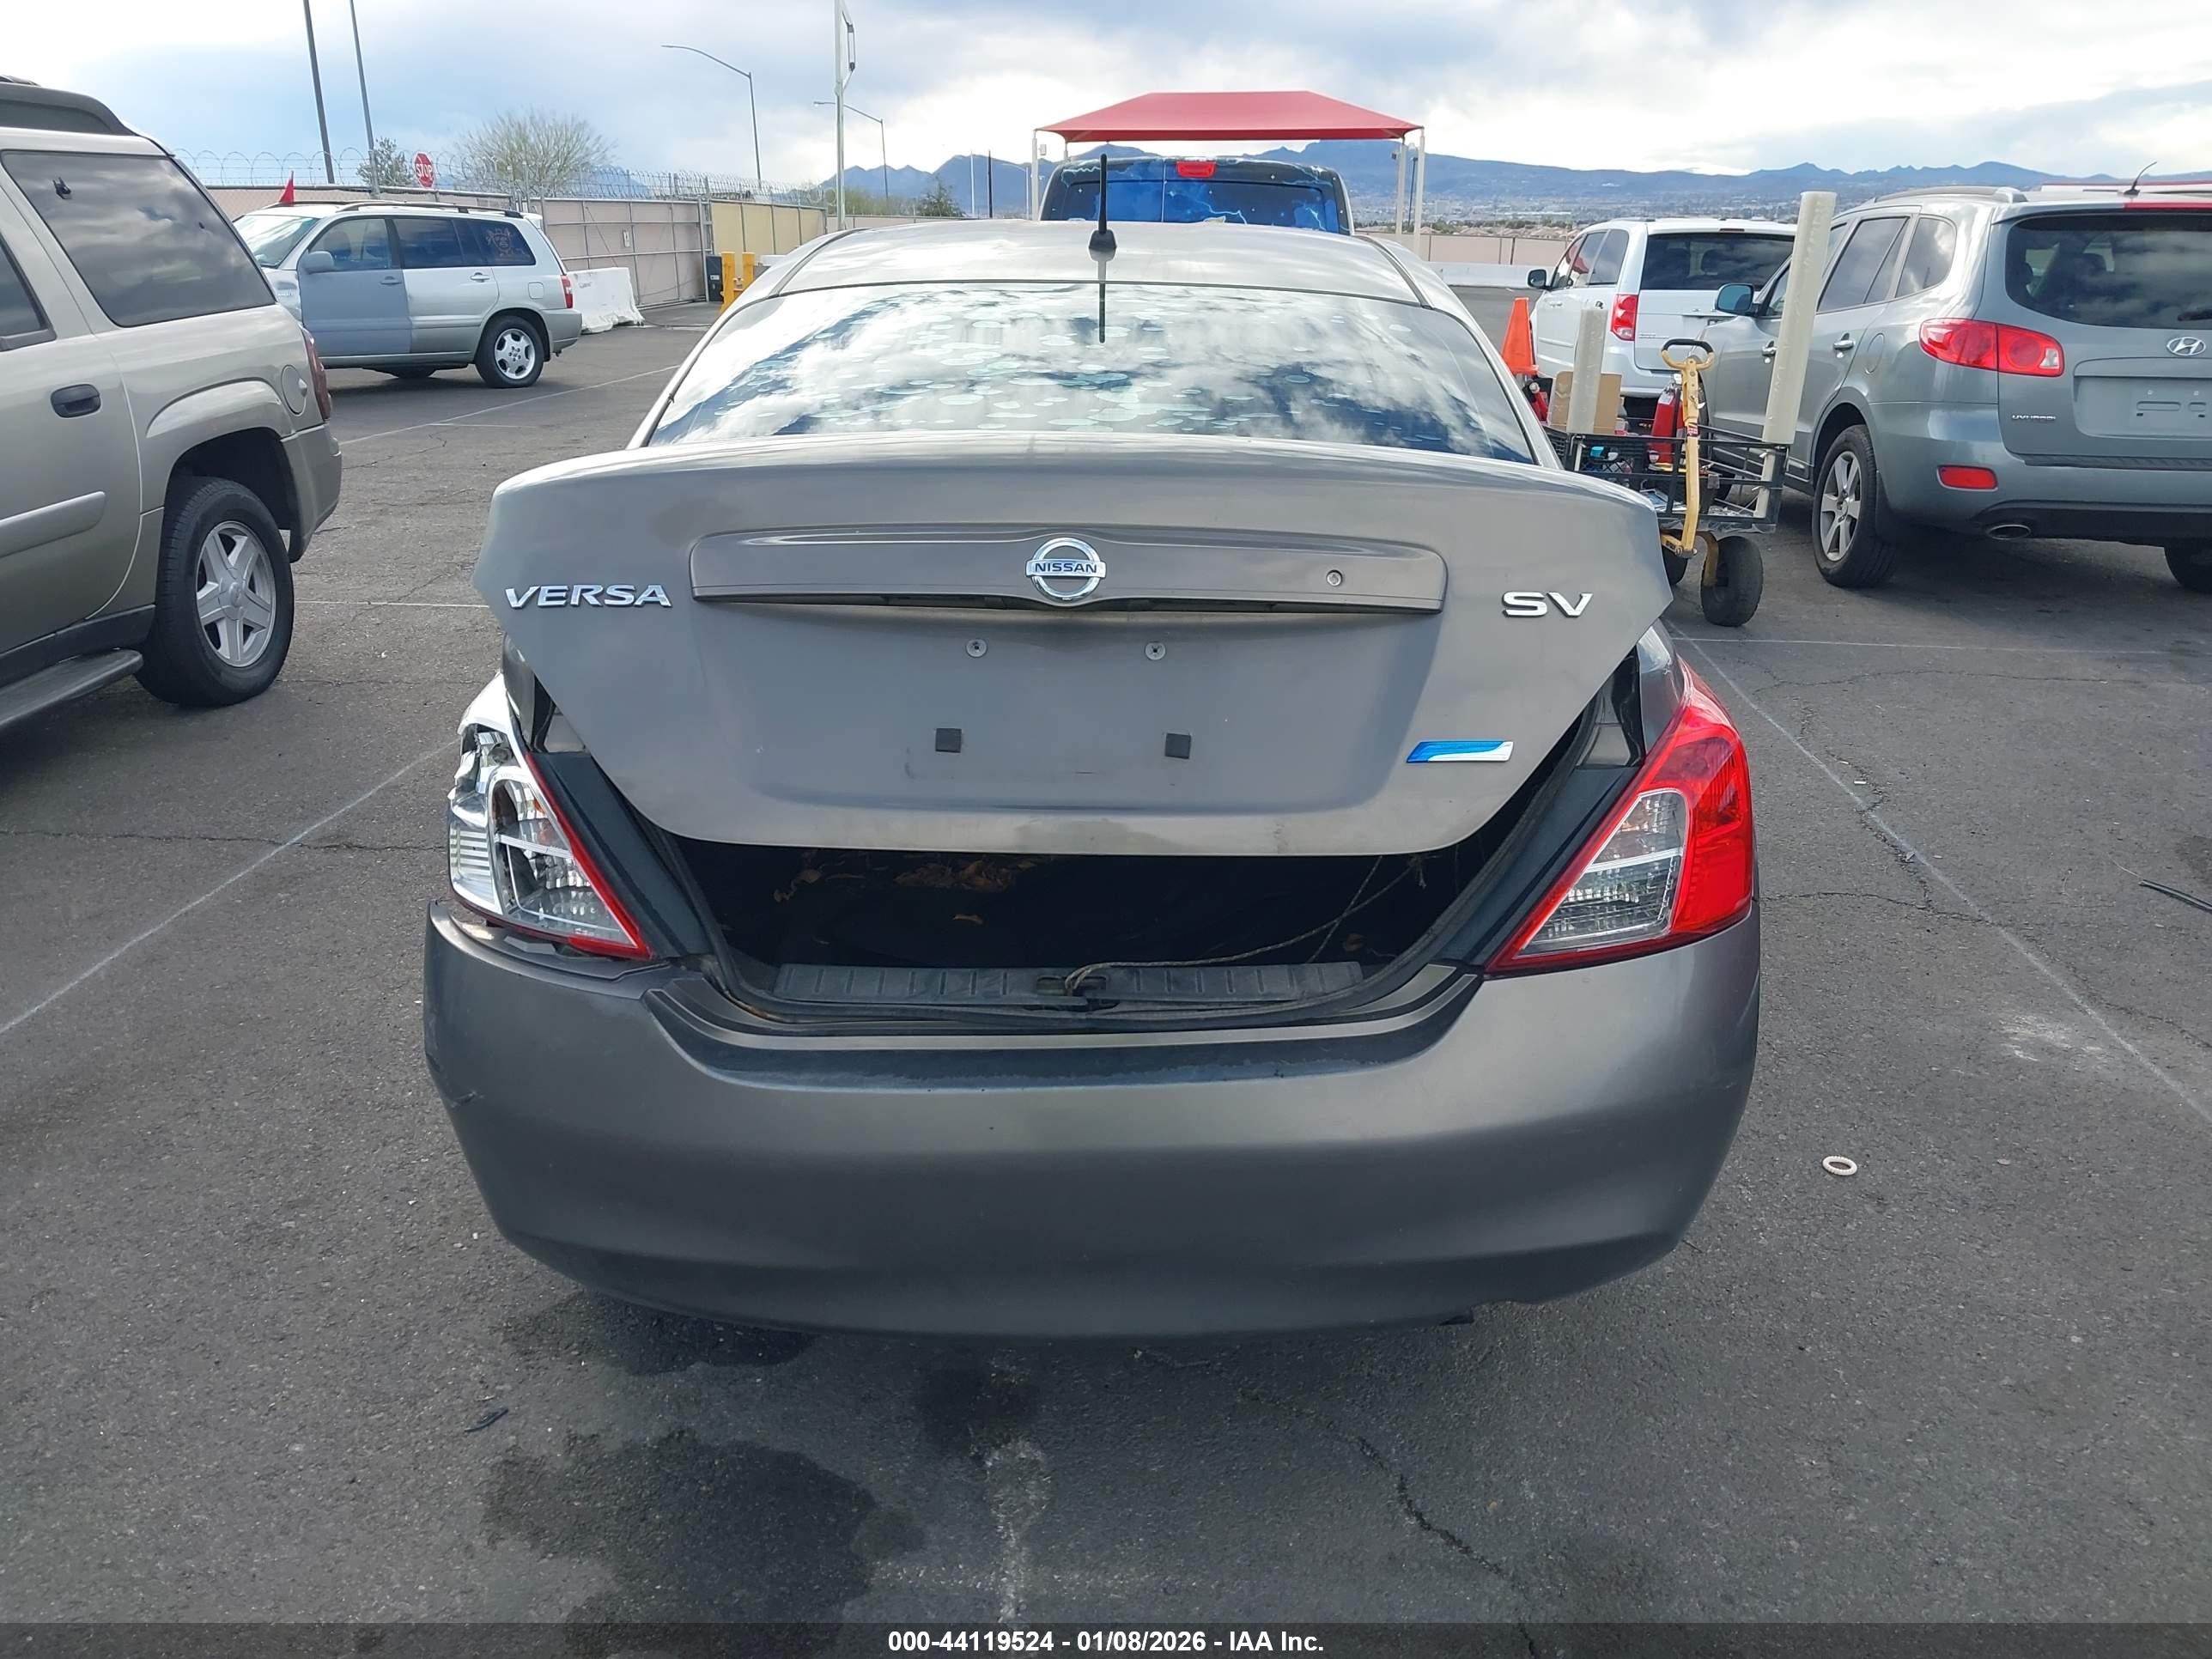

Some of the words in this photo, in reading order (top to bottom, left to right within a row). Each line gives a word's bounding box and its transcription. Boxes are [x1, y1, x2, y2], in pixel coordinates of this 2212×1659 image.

[416, 163, 433, 178] STOP
[1035, 562, 1097, 574] NISSAN
[505, 584, 672, 608] VERSA
[1502, 591, 1593, 617] SV
